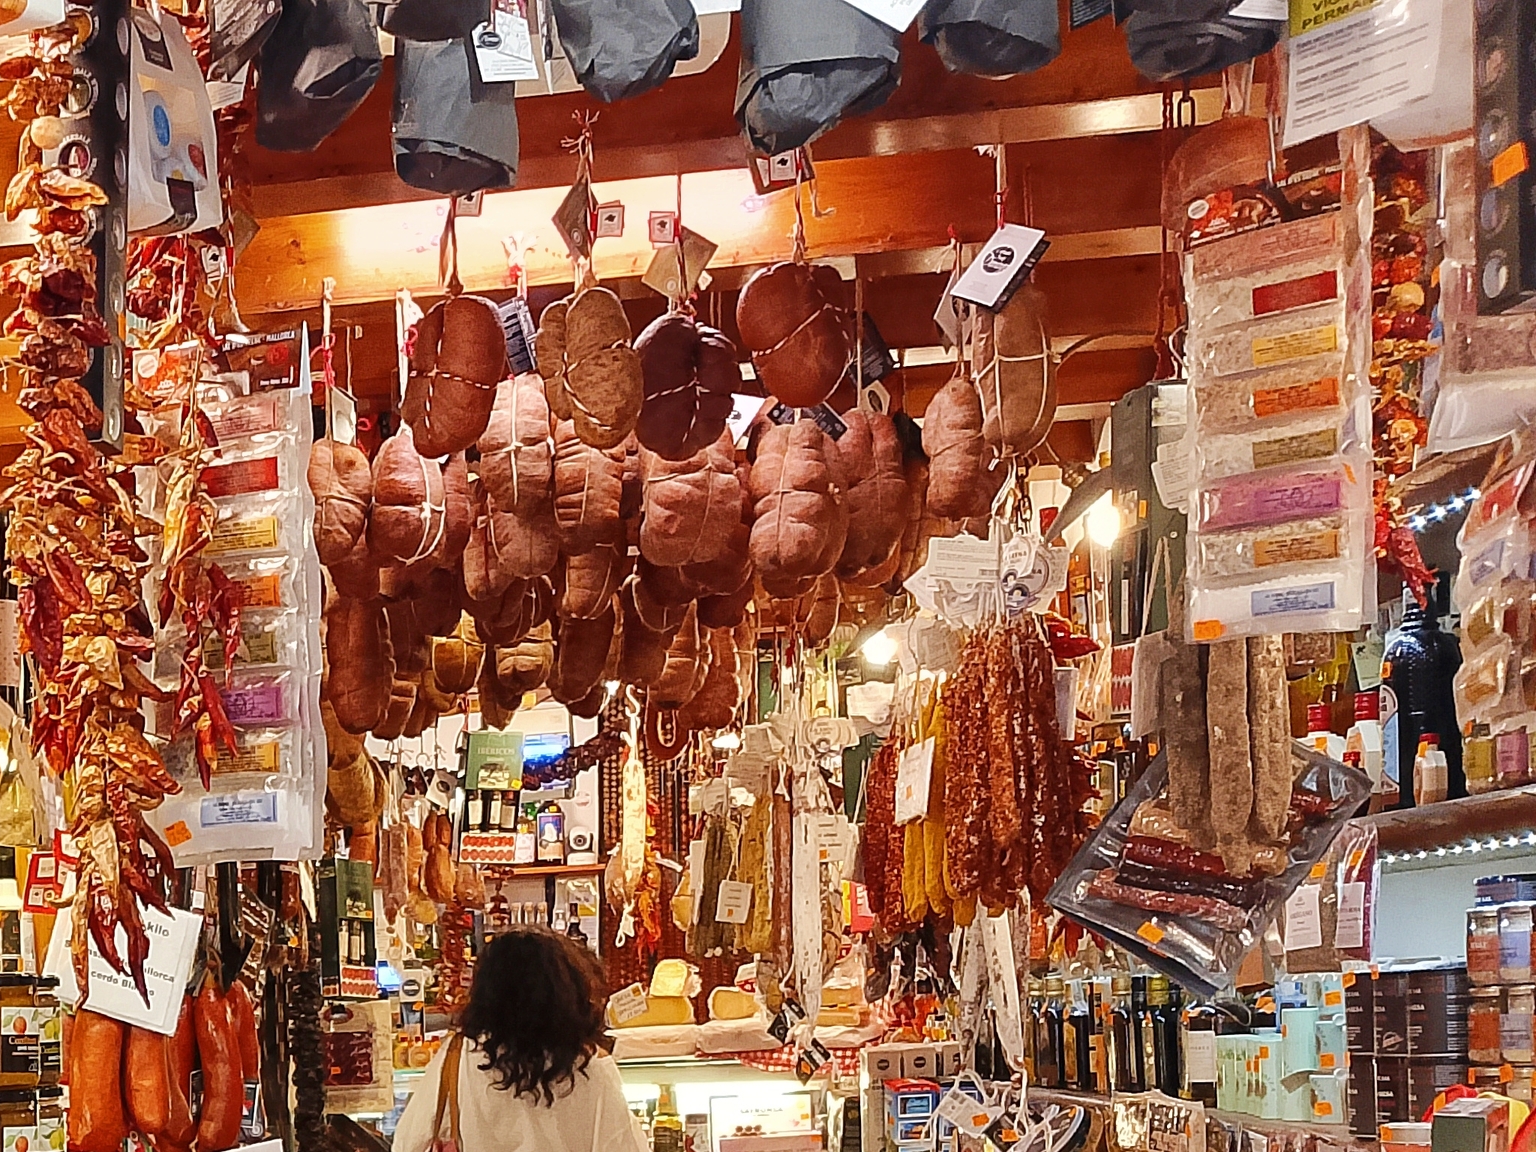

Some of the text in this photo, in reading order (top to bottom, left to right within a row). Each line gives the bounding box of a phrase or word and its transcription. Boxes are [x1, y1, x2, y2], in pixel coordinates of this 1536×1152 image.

[146, 921, 170, 938] kilo
[91, 970, 119, 985] cerdo
[144, 967, 175, 983] llorca
